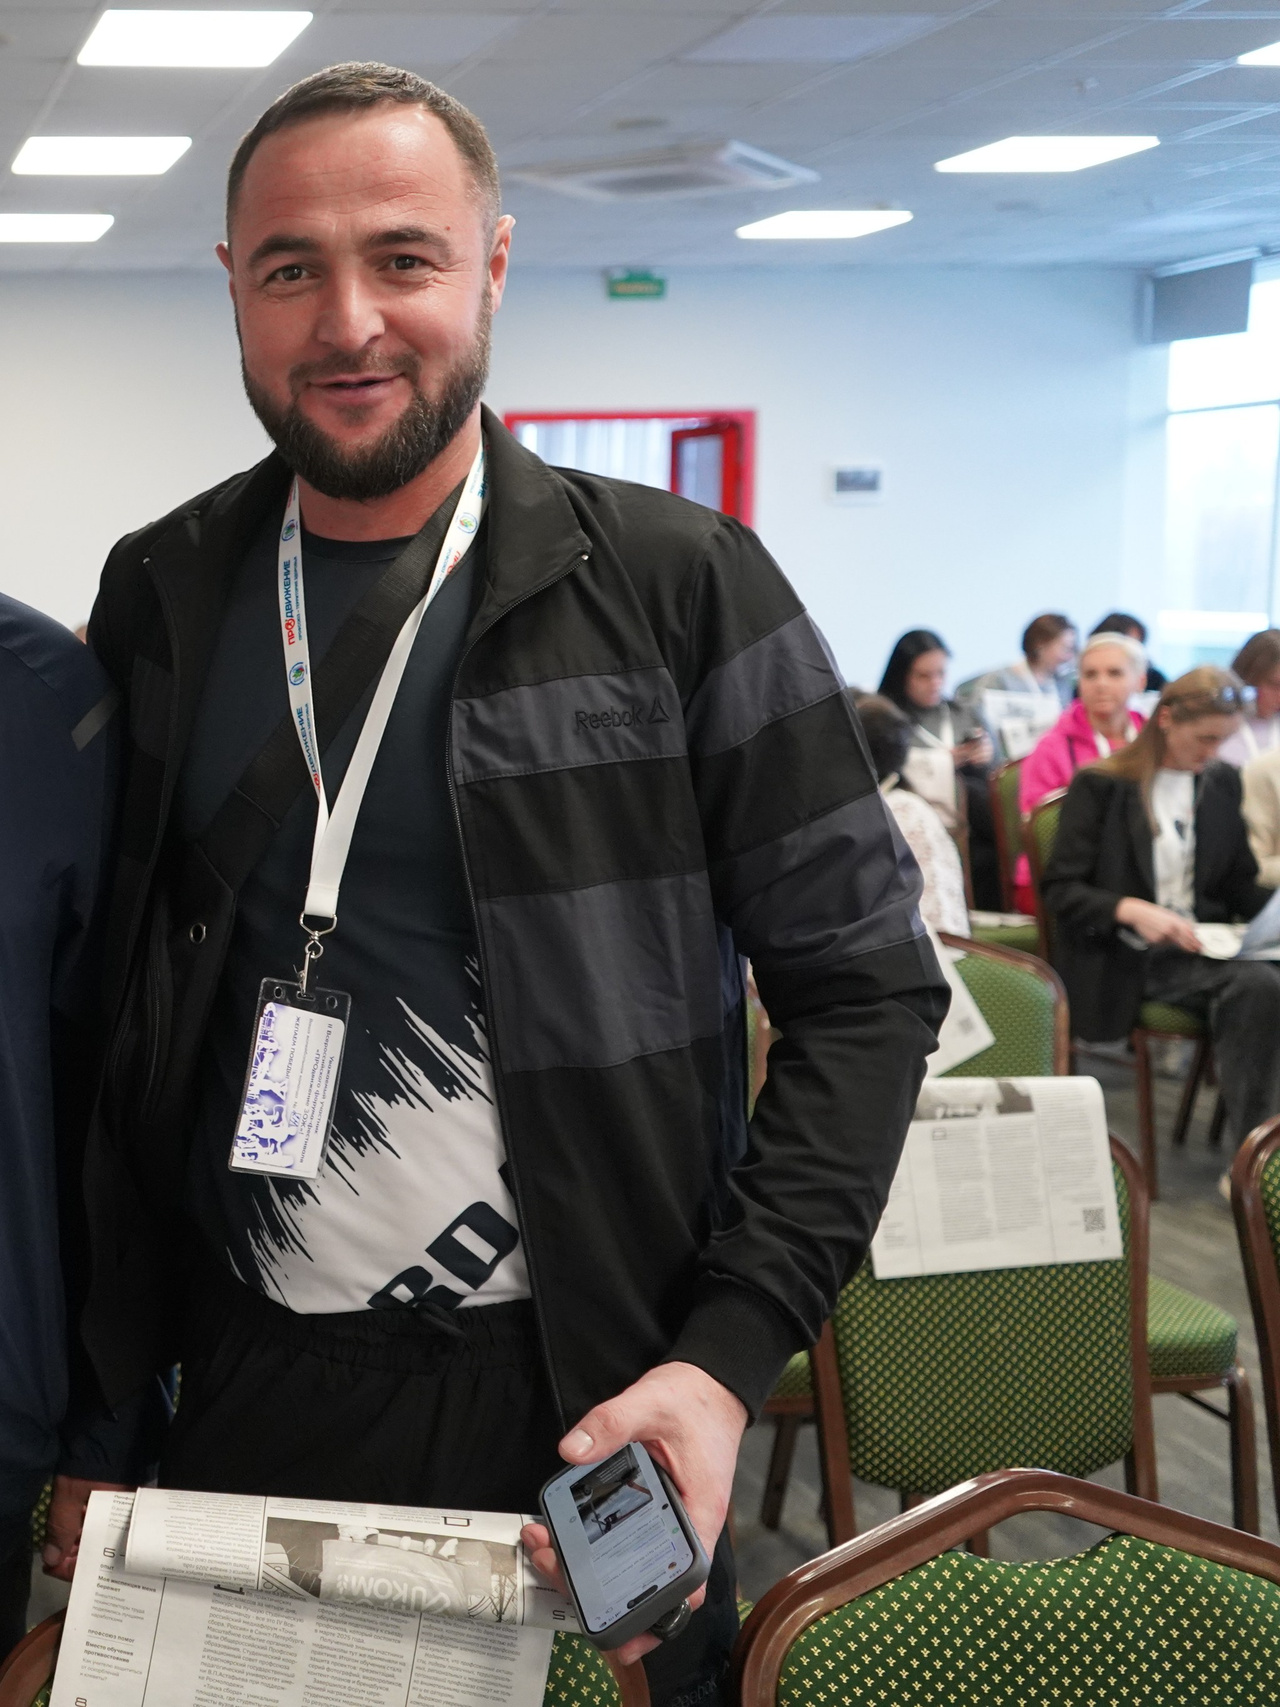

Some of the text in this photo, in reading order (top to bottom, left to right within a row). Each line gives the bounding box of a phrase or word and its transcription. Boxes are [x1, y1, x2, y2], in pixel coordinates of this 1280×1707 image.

[575, 704, 644, 730] Reebok
[285, 1016, 301, 1079] ЖЕЛАЕМ ПОБЕДЫ!
[316, 1030, 331, 1088] Всероссийского
[305, 1049, 321, 1107] «ПРОдвижение
[314, 1056, 334, 1134] Уважаемый участник
[299, 1090, 320, 1163] форума-фестиваля
[96, 1582, 121, 1594] бережет
[88, 1629, 135, 1643] ПРОФСОЮЗ ПОМОГ
[209, 1612, 298, 1635] российский медиафорум «Точка
[86, 1640, 134, 1657] Вместо обучения
[207, 1625, 294, 1650] Масштабное событие организо-
[219, 1635, 267, 1651] Общероссийский
[267, 1646, 297, 1658] Профсоюз
[84, 1650, 129, 1664] противостояние
